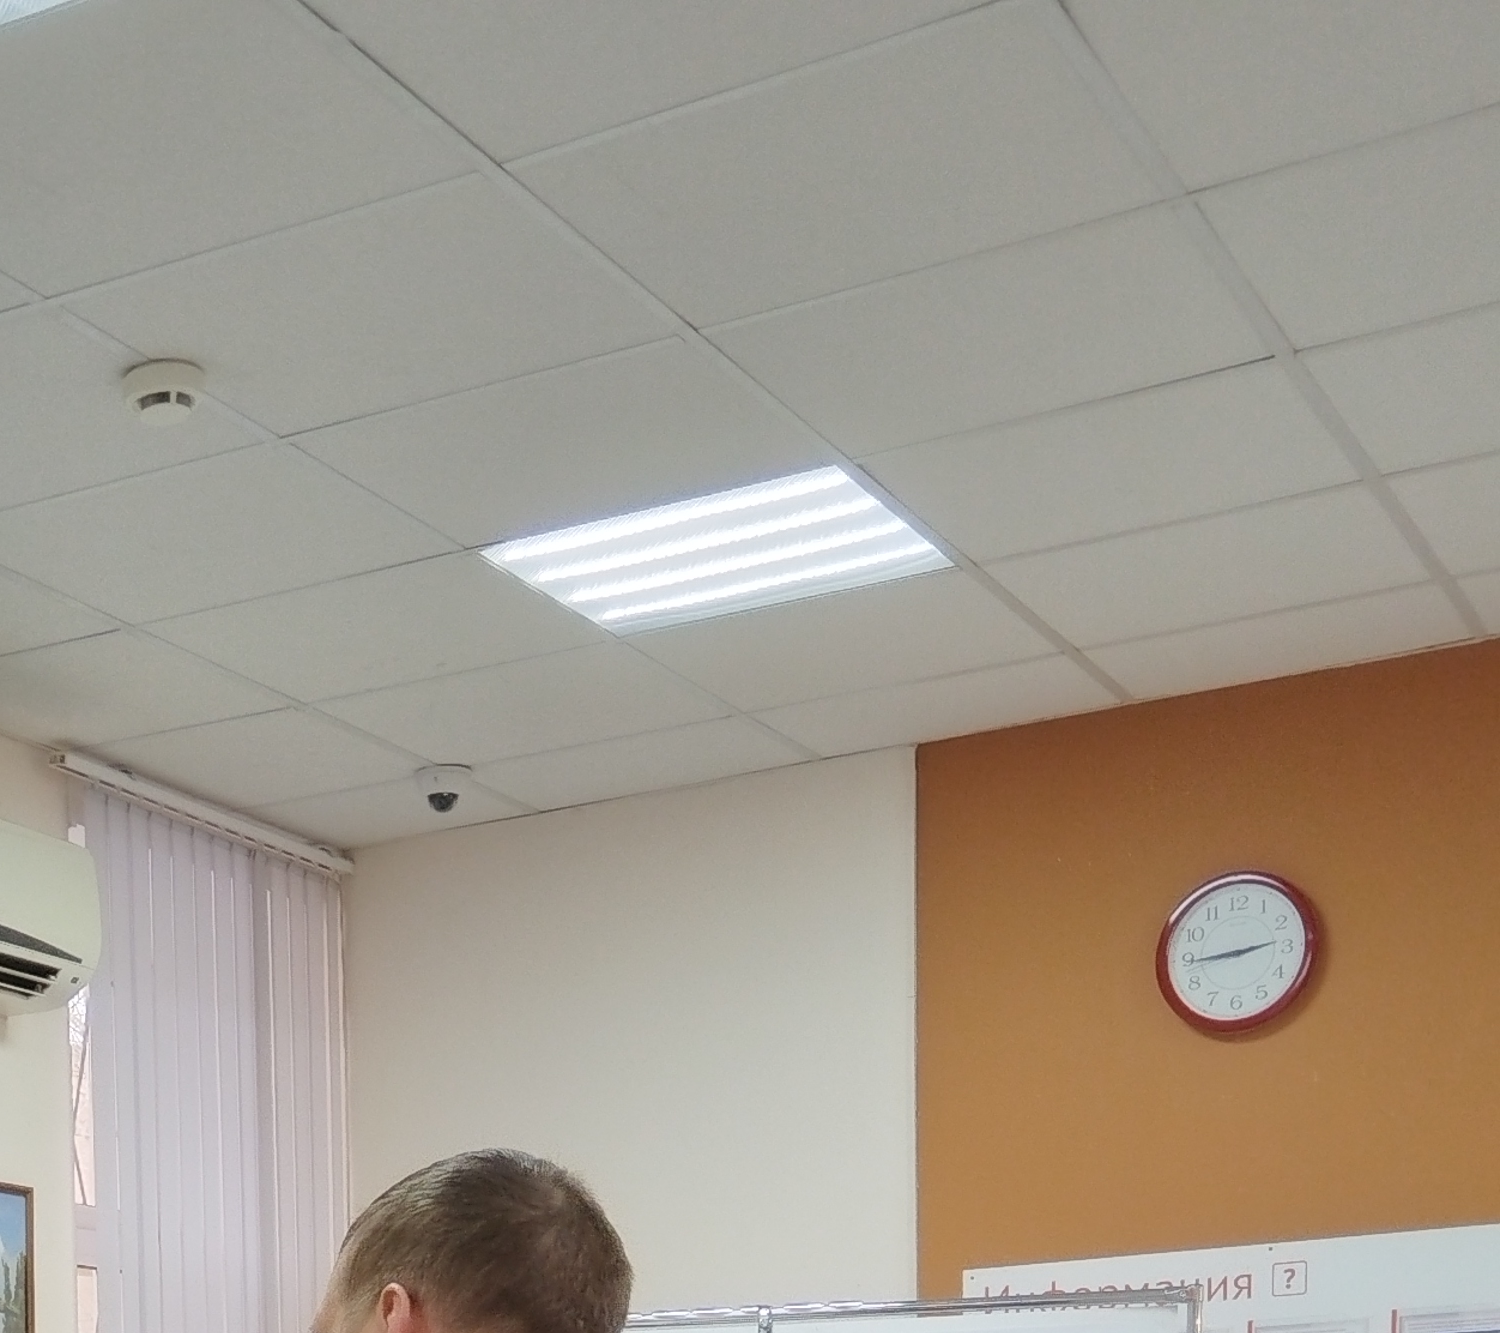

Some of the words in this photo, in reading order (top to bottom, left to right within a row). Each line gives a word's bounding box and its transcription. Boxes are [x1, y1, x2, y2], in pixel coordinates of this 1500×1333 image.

[1229, 895, 1249, 911] 12
[1260, 899, 1266, 914] 1
[1205, 906, 1219, 921] 11
[1275, 915, 1288, 930] 2
[1187, 926, 1205, 942] 10
[1281, 939, 1294, 954] 3
[1182, 952, 1195, 967] 9
[1272, 964, 1285, 979] 4
[1188, 976, 1201, 990] 8
[1207, 991, 1219, 1006] 7
[1255, 985, 1268, 1000] 5
[1230, 995, 1243, 1010] 6
